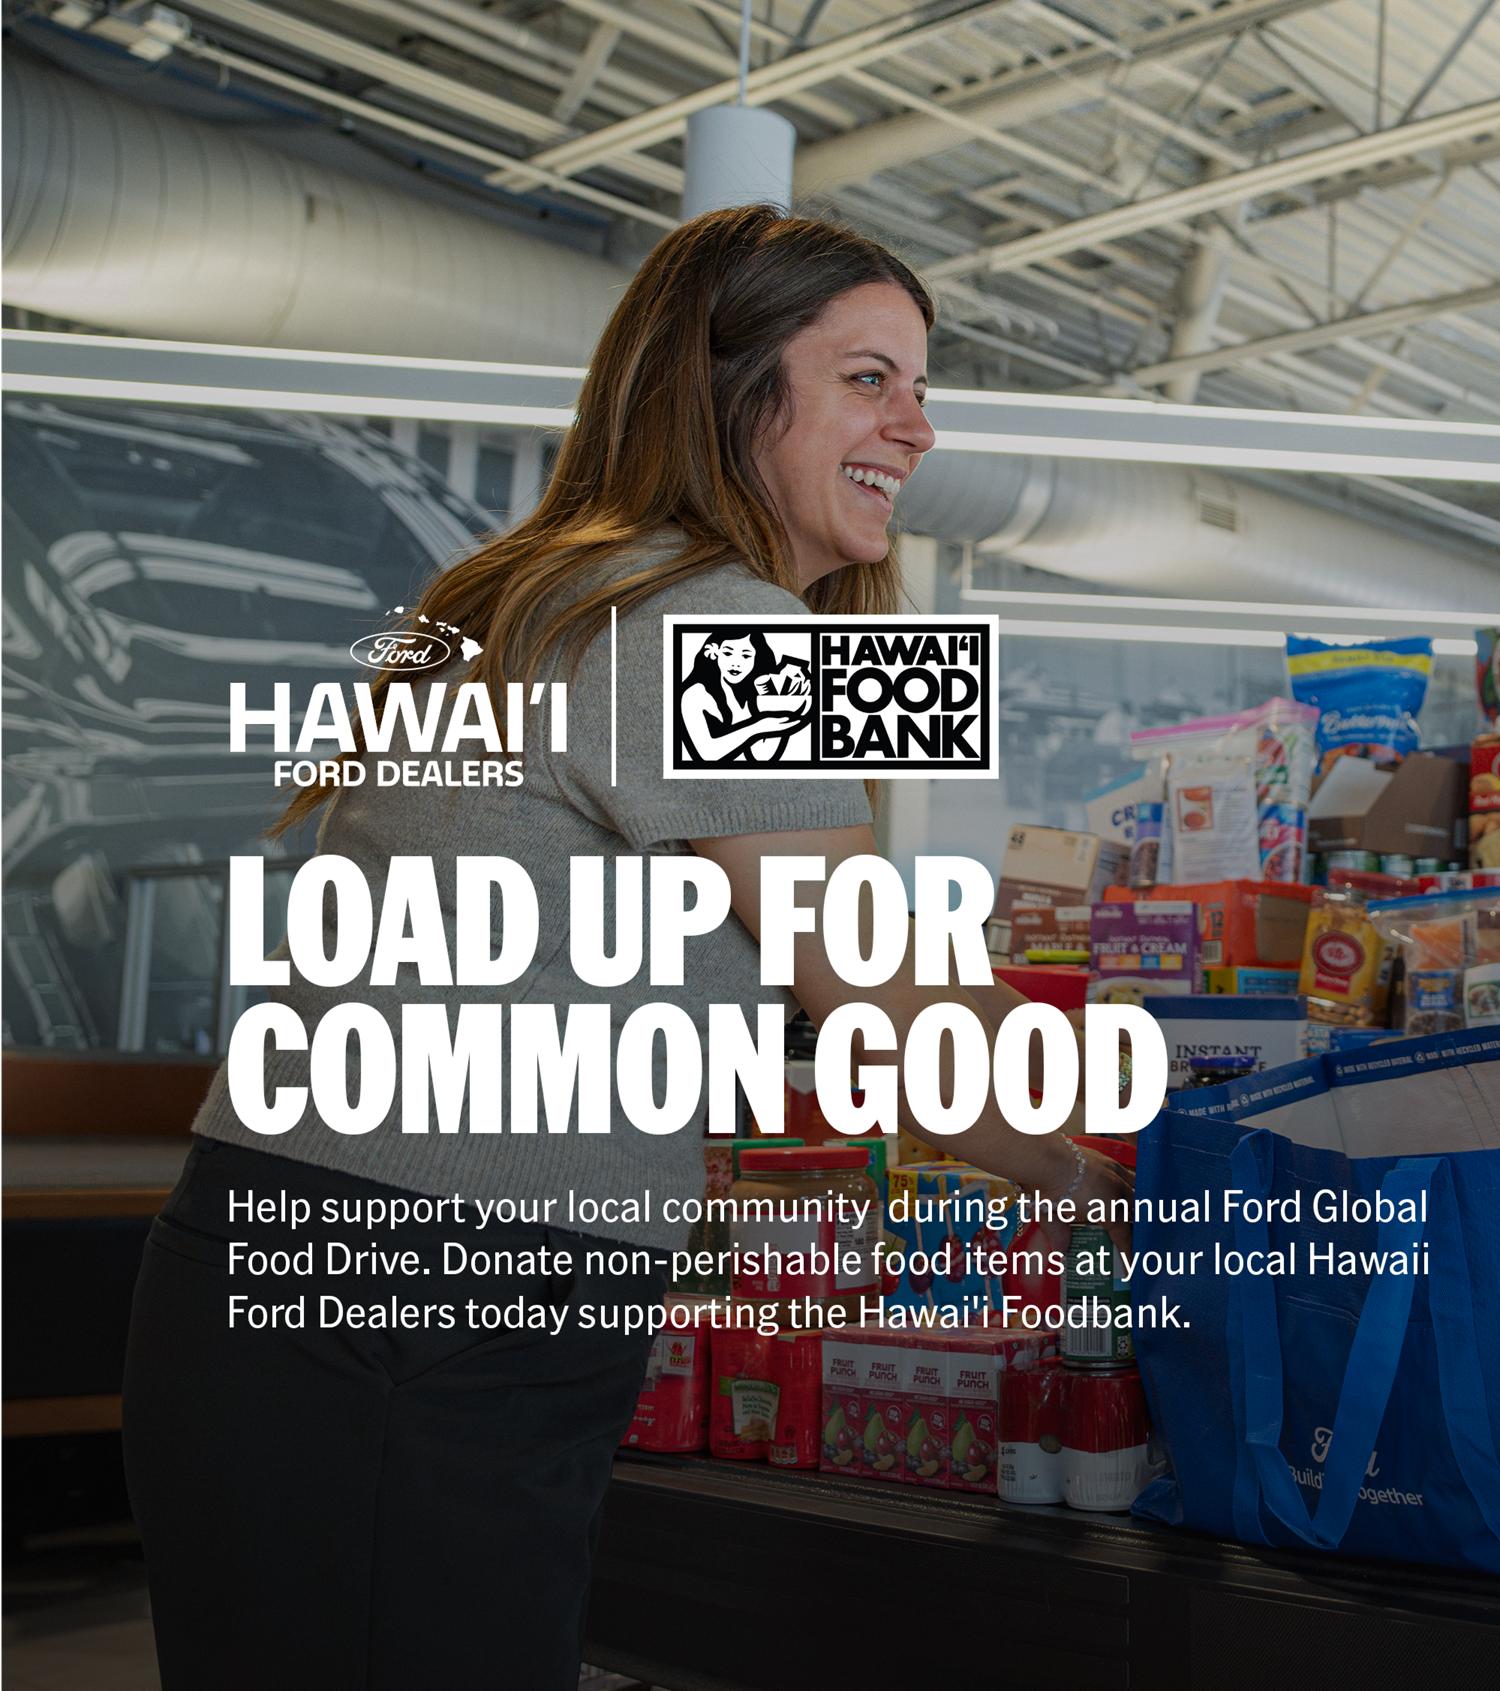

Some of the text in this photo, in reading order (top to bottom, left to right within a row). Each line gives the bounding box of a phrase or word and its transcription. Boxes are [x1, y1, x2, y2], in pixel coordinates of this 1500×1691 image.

[1092, 942, 1188, 954] FRUIT & CREAM
[1188, 1106, 1207, 1116] MADE
[1208, 1103, 1226, 1114] WITH
[832, 1358, 856, 1368] FRUIT
[871, 1362, 897, 1372] FRUIT
[915, 1366, 939, 1377] FRUIT
[959, 1370, 987, 1380] FRUIT
[1288, 1465, 1325, 1490] Build
[1359, 1486, 1424, 1506] ogether
